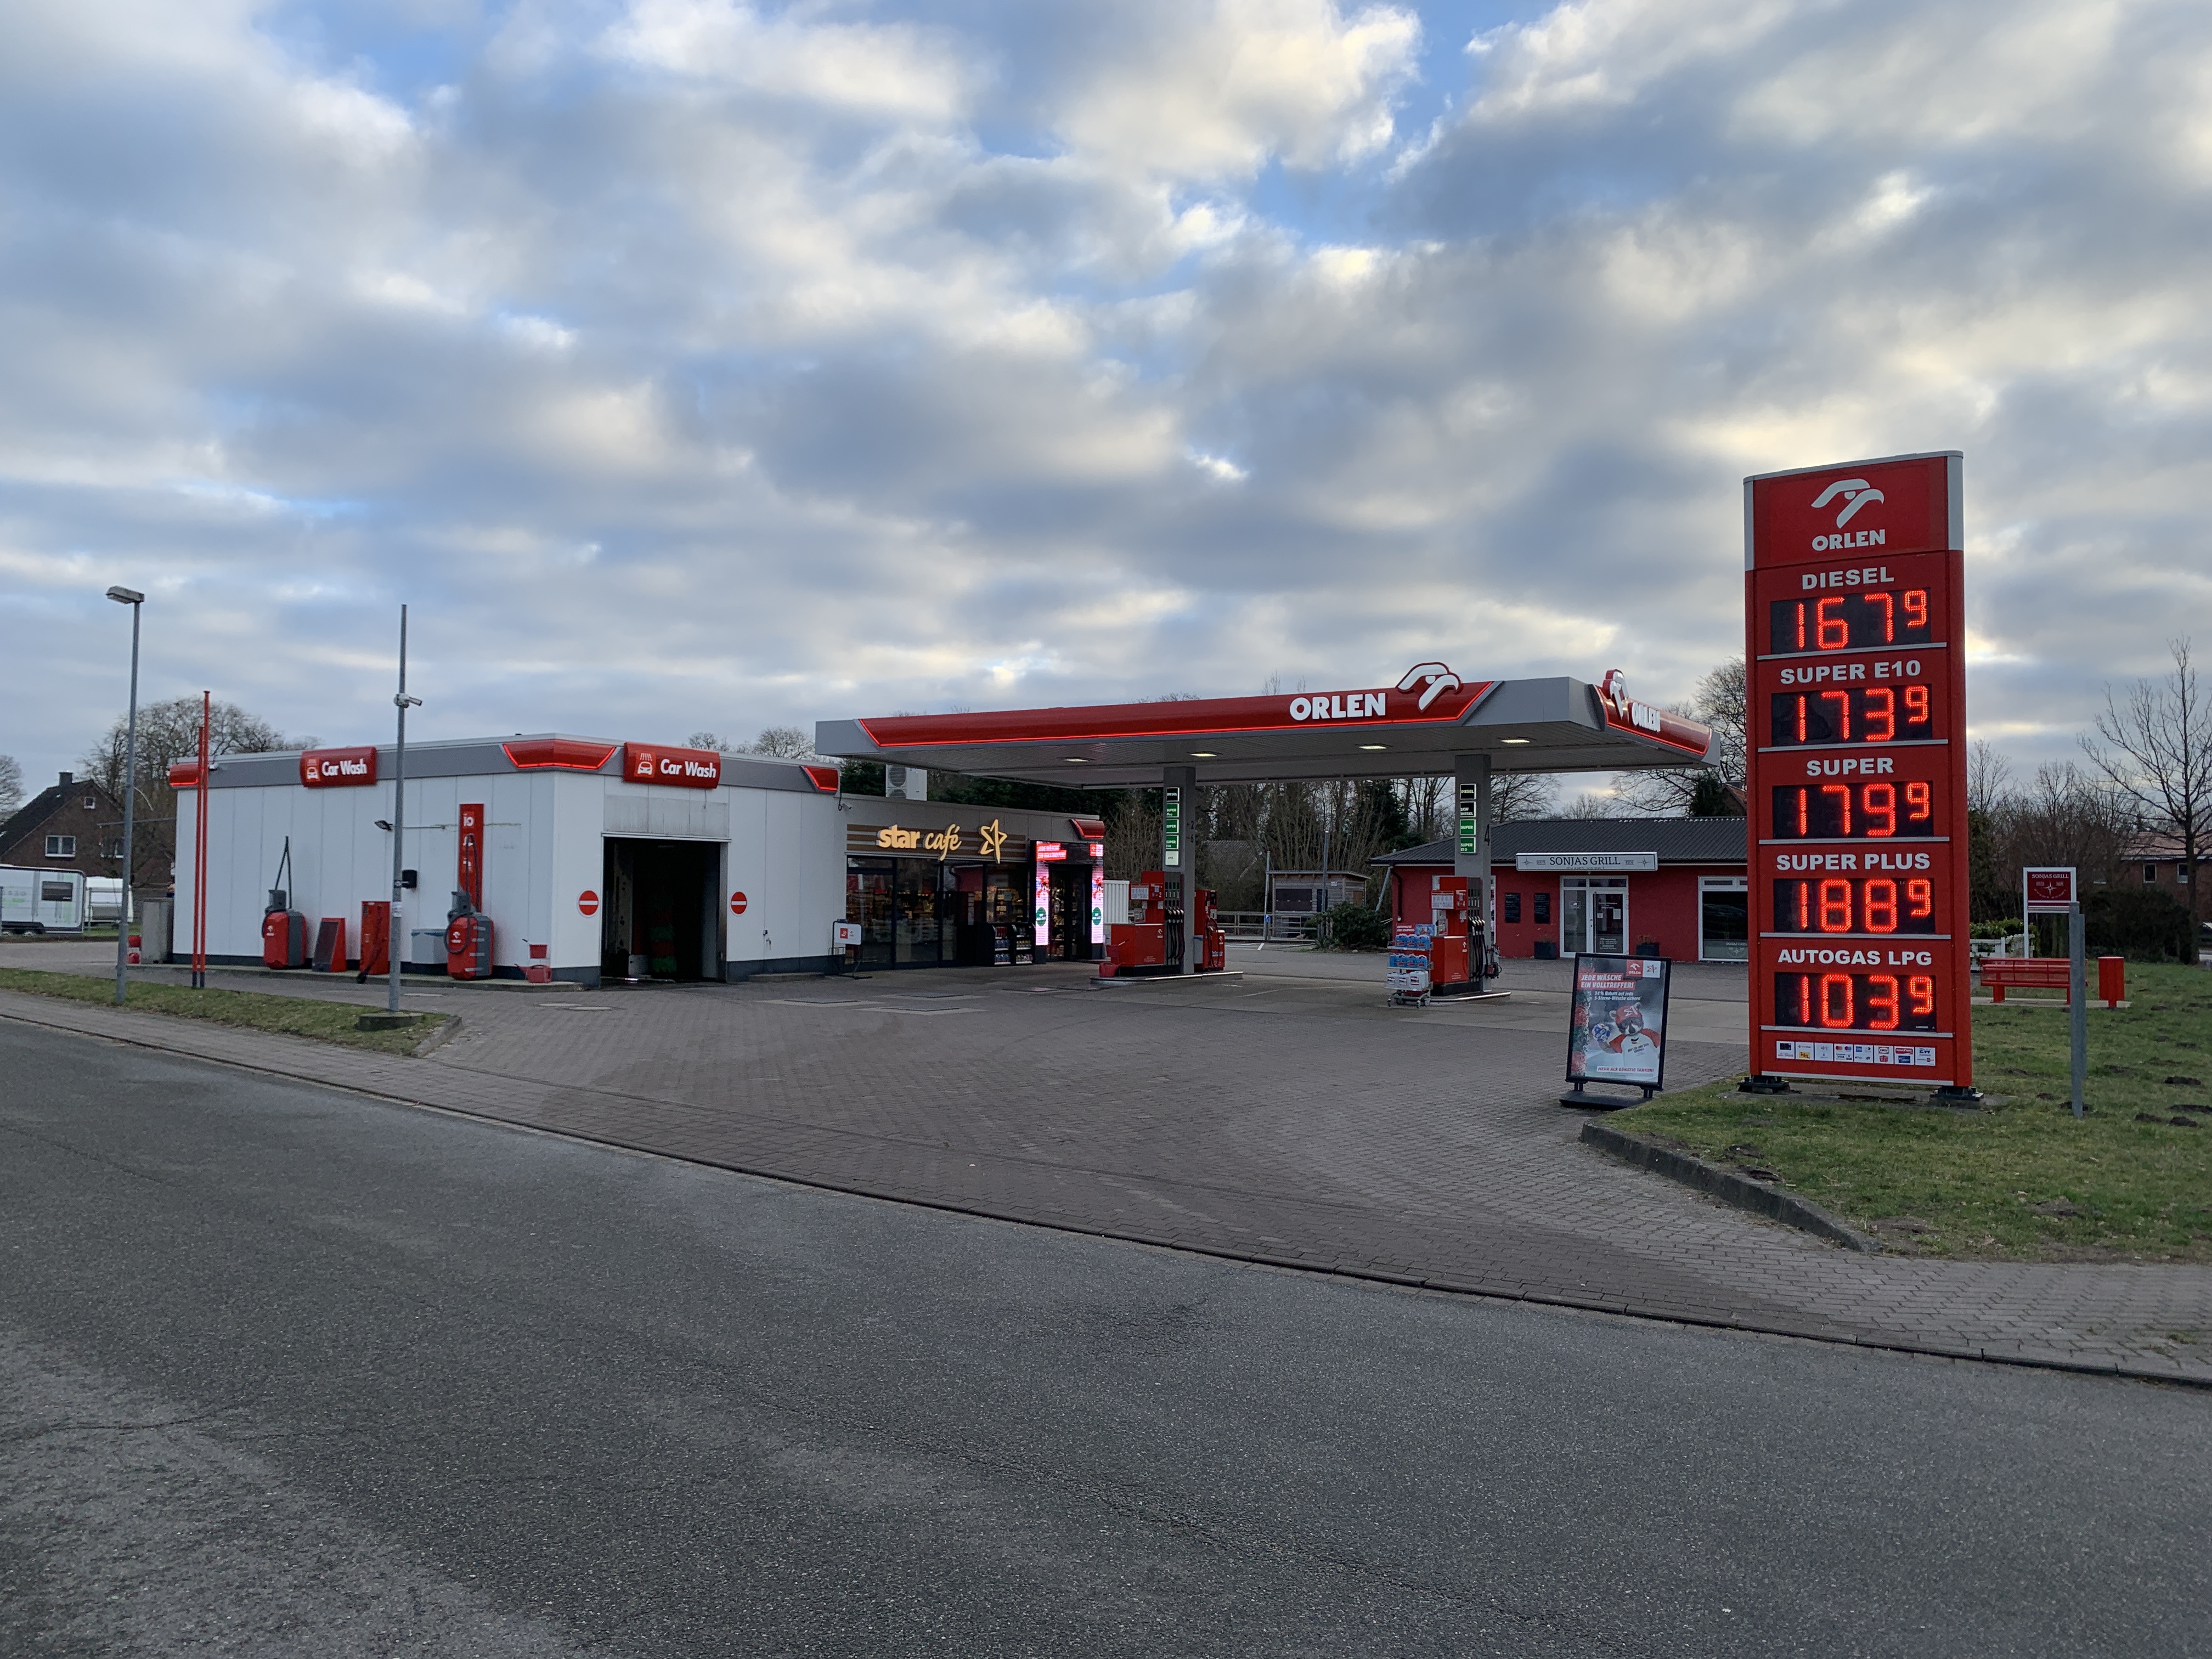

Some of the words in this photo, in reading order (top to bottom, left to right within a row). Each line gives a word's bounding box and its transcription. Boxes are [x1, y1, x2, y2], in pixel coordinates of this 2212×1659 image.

[1812, 529, 1886, 551] ORLEN
[1802, 567, 1894, 590] DIESEL
[1780, 664, 1865, 685] SUPER
[1875, 659, 1921, 679] E10
[1290, 692, 1386, 721] ORLEN
[321, 761, 339, 776] Car
[340, 758, 367, 775] Wash
[660, 758, 682, 775] Car
[685, 760, 716, 778] Wash
[1807, 757, 1894, 776] SUPER
[877, 824, 920, 849] star
[923, 823, 962, 861] café
[1550, 856, 1588, 866] SONJAS
[1590, 856, 1621, 865] GRILL
[1776, 854, 1857, 870] SUPER
[1865, 853, 1930, 870] PLUS
[1778, 949, 1881, 966] AUTOGAS
[1888, 951, 1932, 966] LPG
